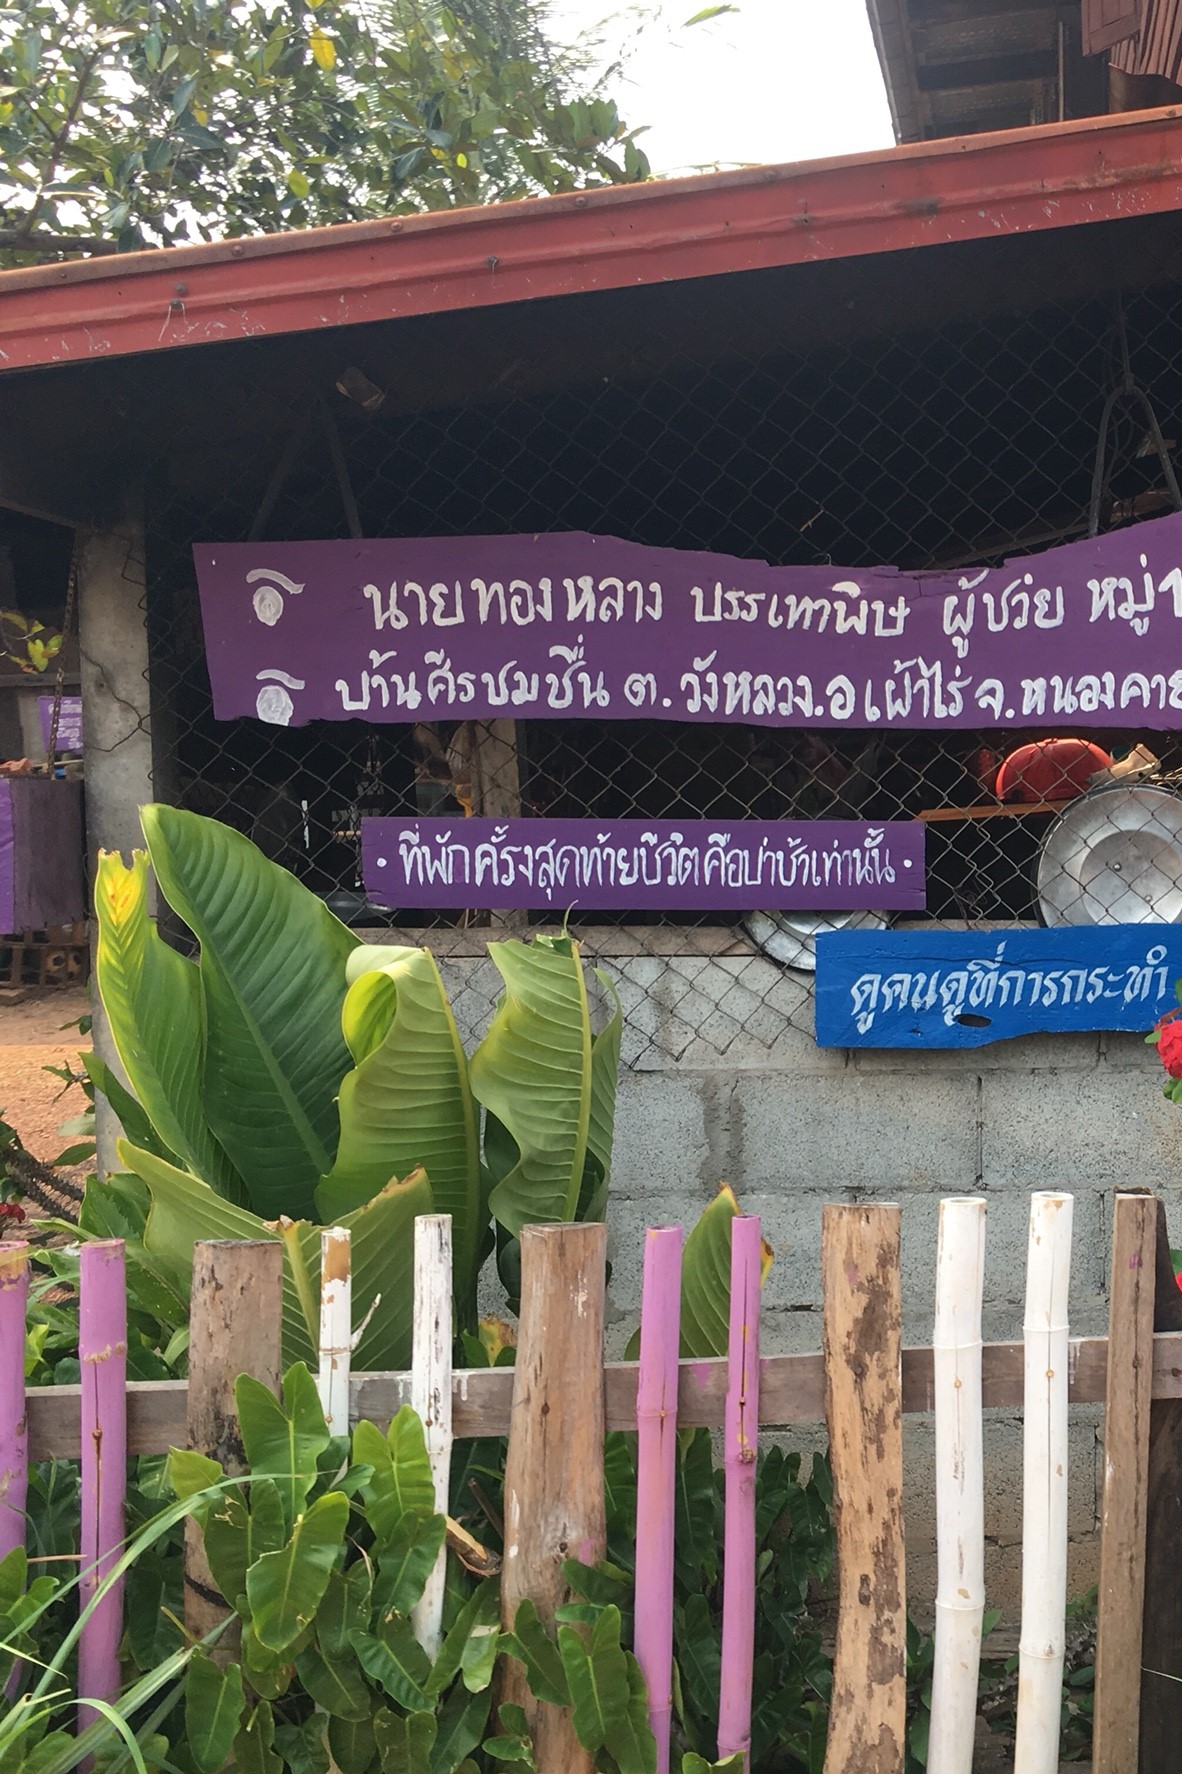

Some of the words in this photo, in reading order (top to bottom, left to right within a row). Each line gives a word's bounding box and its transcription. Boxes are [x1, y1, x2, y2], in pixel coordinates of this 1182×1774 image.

[363, 576, 663, 631] นายทองหลาง
[943, 568, 1065, 659] ผู้ช่วย
